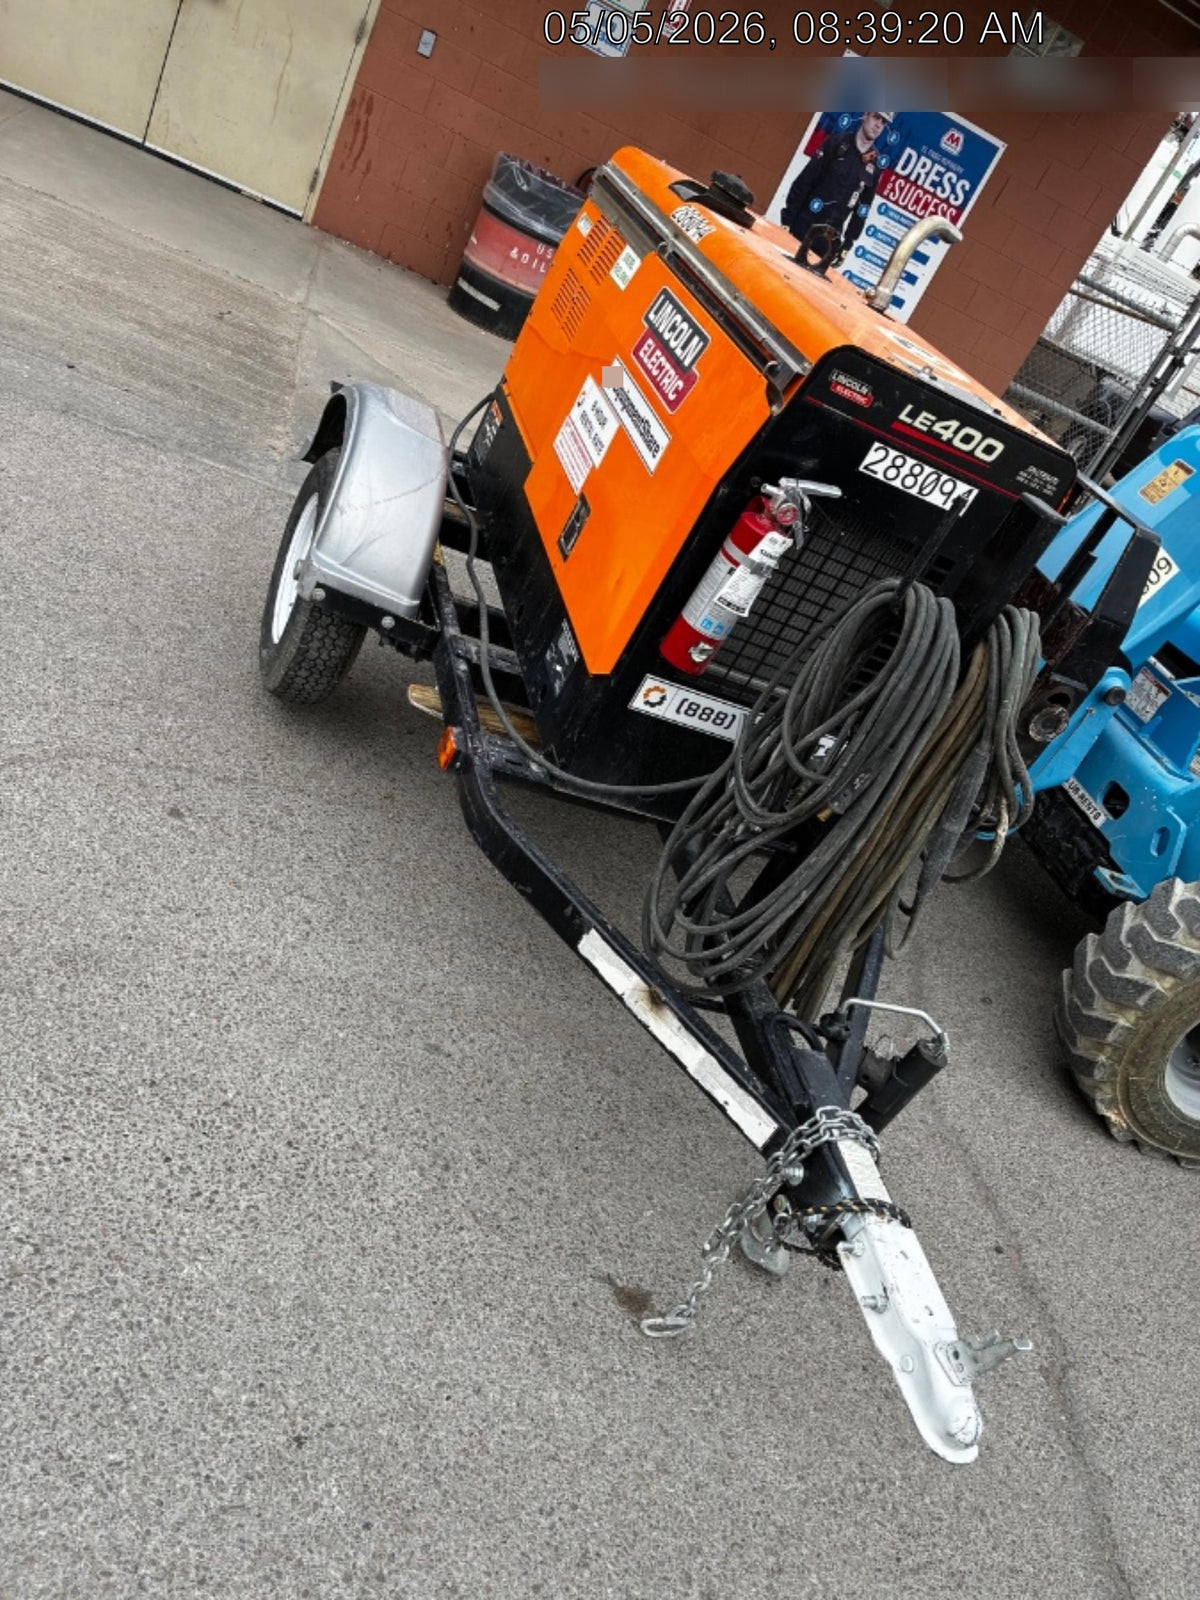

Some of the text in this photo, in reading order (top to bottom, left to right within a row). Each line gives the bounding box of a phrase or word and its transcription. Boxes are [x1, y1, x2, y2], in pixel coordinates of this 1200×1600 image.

[895, 146, 971, 206] DRESS
[647, 294, 705, 368] LINCOLN
[637, 337, 684, 401] ELECTRIC
[830, 371, 869, 395] LINCOLN
[610, 386, 661, 459] quipmentShare
[898, 403, 1005, 463] LE400
[674, 697, 738, 731] (888)
